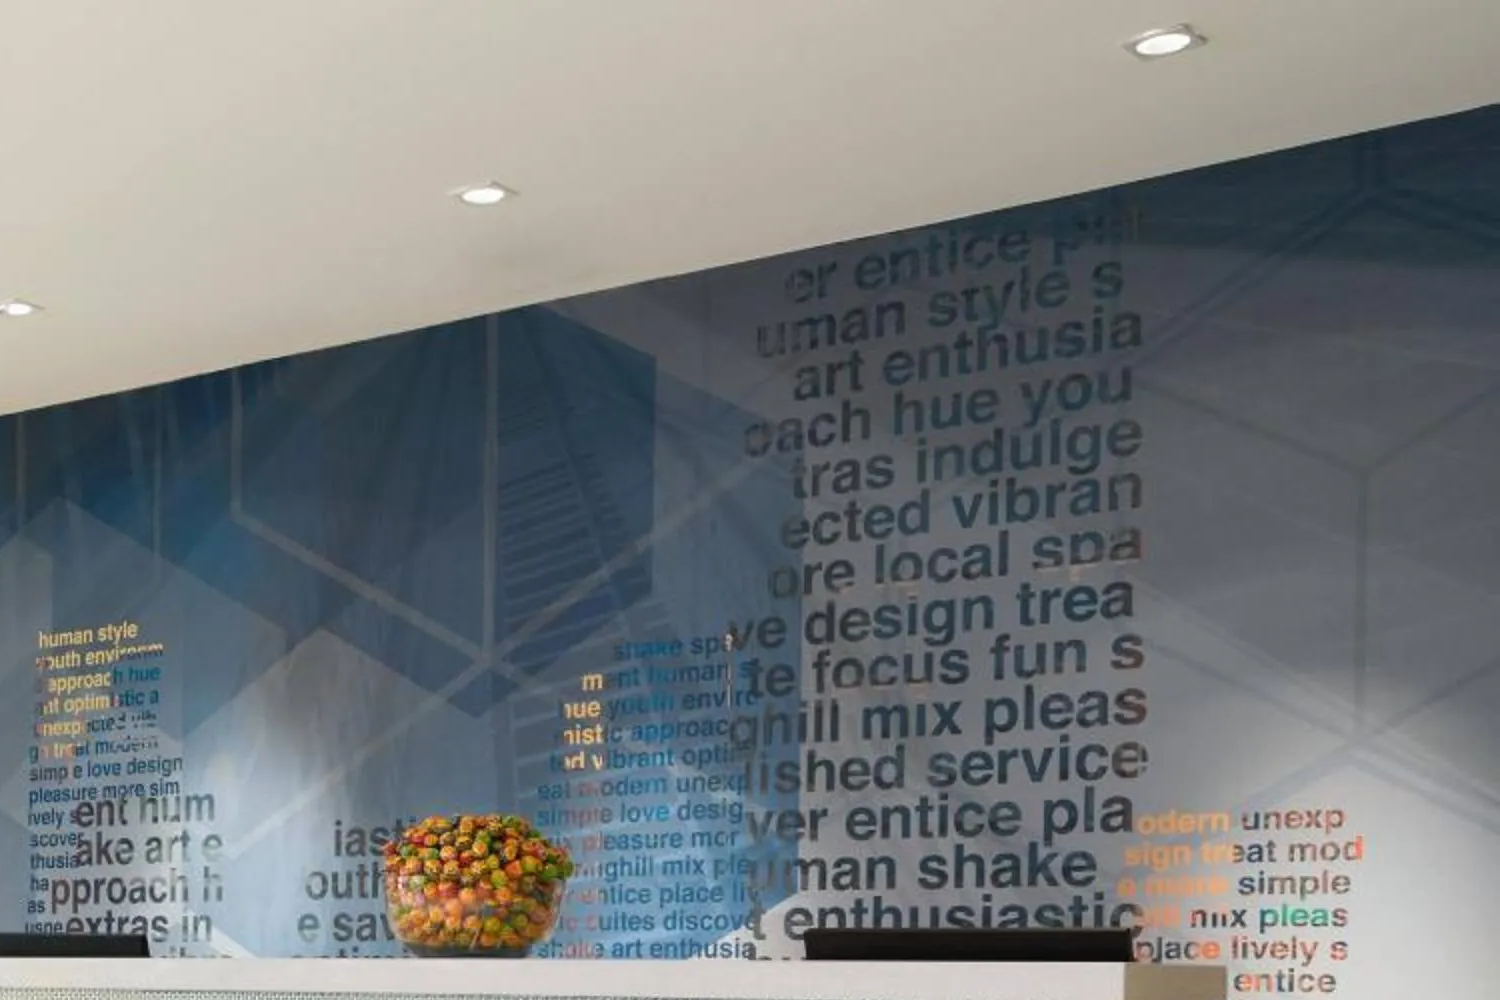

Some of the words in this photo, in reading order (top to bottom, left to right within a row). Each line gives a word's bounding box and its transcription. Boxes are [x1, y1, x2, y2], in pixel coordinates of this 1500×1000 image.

[854, 226, 1031, 291] entice
[758, 300, 905, 357] uman
[928, 267, 1070, 330] style
[1092, 260, 1124, 298] s
[794, 350, 863, 401] art
[883, 306, 1142, 385] enthusia
[893, 387, 997, 435] hue
[1020, 367, 1132, 426] you
[917, 416, 1142, 483] indulge
[781, 488, 930, 549] ected
[952, 471, 1142, 529] vibran
[768, 557, 854, 600] ore
[875, 531, 1009, 585] local
[38, 628, 93, 649] human
[97, 620, 139, 645] style
[804, 593, 994, 647] design
[1016, 580, 1134, 627] trea
[129, 666, 161, 682] hue
[812, 649, 970, 694] focus
[991, 634, 1087, 681] fun
[1111, 633, 1145, 670] s
[861, 699, 962, 741] mix
[984, 685, 1147, 746] pleas
[87, 760, 121, 778] love
[127, 756, 183, 777] design
[743, 745, 905, 797] lished
[927, 735, 1148, 788] service
[29, 787, 97, 807] pleasure
[102, 783, 145, 799] more
[620, 803, 669, 824] love
[677, 799, 745, 825] desig
[745, 807, 828, 844] ver
[845, 793, 1021, 842] entice
[1043, 786, 1134, 847] pla
[1136, 808, 1231, 836] odern
[1242, 808, 1345, 834] unexp
[662, 853, 706, 877] mix
[917, 841, 1097, 890] shake
[1124, 841, 1192, 870] sign
[1288, 836, 1364, 862] mod
[51, 867, 189, 914] pproach
[659, 880, 724, 909] place
[1238, 870, 1351, 900] simple
[784, 891, 1144, 940] enthusiastic
[1260, 903, 1349, 934] pleas
[611, 937, 645, 958] art
[650, 933, 757, 960] enthusia
[1135, 937, 1221, 963] place
[1231, 935, 1320, 966] lively
[1330, 941, 1348, 961] s
[1234, 967, 1337, 993] entice
